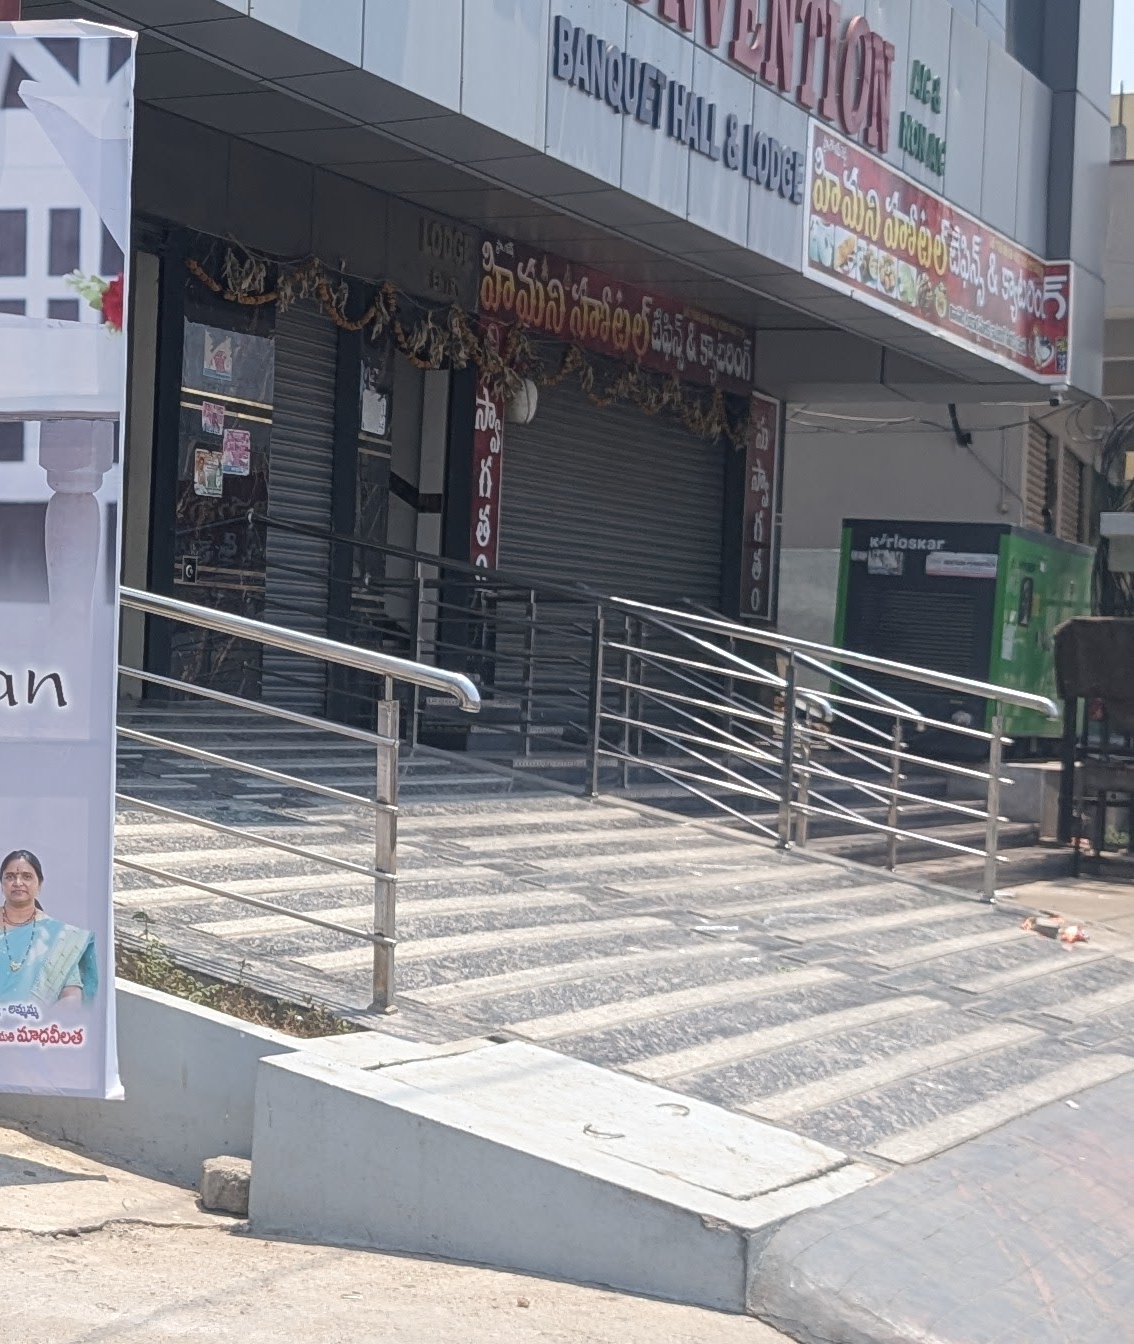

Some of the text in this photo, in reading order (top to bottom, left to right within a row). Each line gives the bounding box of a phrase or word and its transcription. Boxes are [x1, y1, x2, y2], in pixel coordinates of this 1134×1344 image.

[553, 14, 804, 206] BANQUET HALL & LODGE
[898, 110, 927, 163] NON
[883, 191, 952, 276] హోటల్
[987, 253, 998, 297] &
[569, 277, 653, 357] హోటల్
[686, 321, 697, 363] &
[8, 1003, 40, 1020] అమ్మమ్మ
[17, 1024, 84, 1047] మాధవీలత
